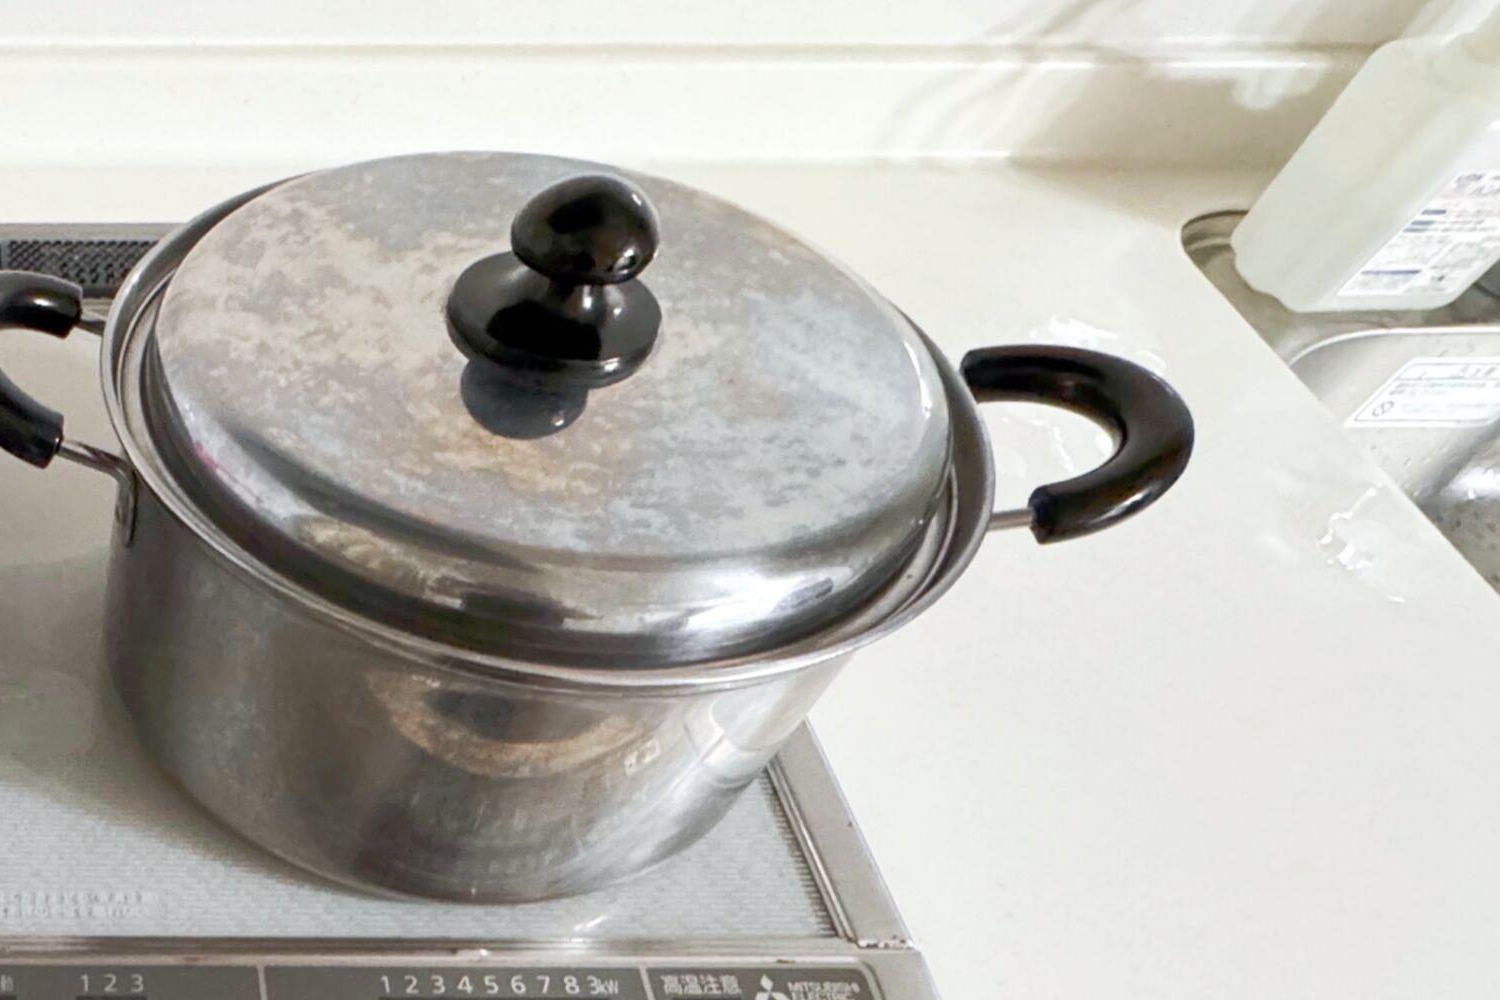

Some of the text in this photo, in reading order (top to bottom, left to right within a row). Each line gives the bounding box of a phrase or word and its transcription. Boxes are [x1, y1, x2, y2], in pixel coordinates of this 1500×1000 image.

[80, 974, 144, 992] 1 2 3
[381, 975, 391, 994] 1
[405, 975, 419, 994] 2
[431, 975, 446, 994] 3
[457, 975, 473, 994] 4
[484, 975, 499, 994] 5
[511, 975, 526, 994] 6
[537, 975, 550, 994] 7
[564, 975, 580, 994] 8
[660, 974, 742, 995] 高温注意
[787, 981, 860, 993] MITSUBISHI
